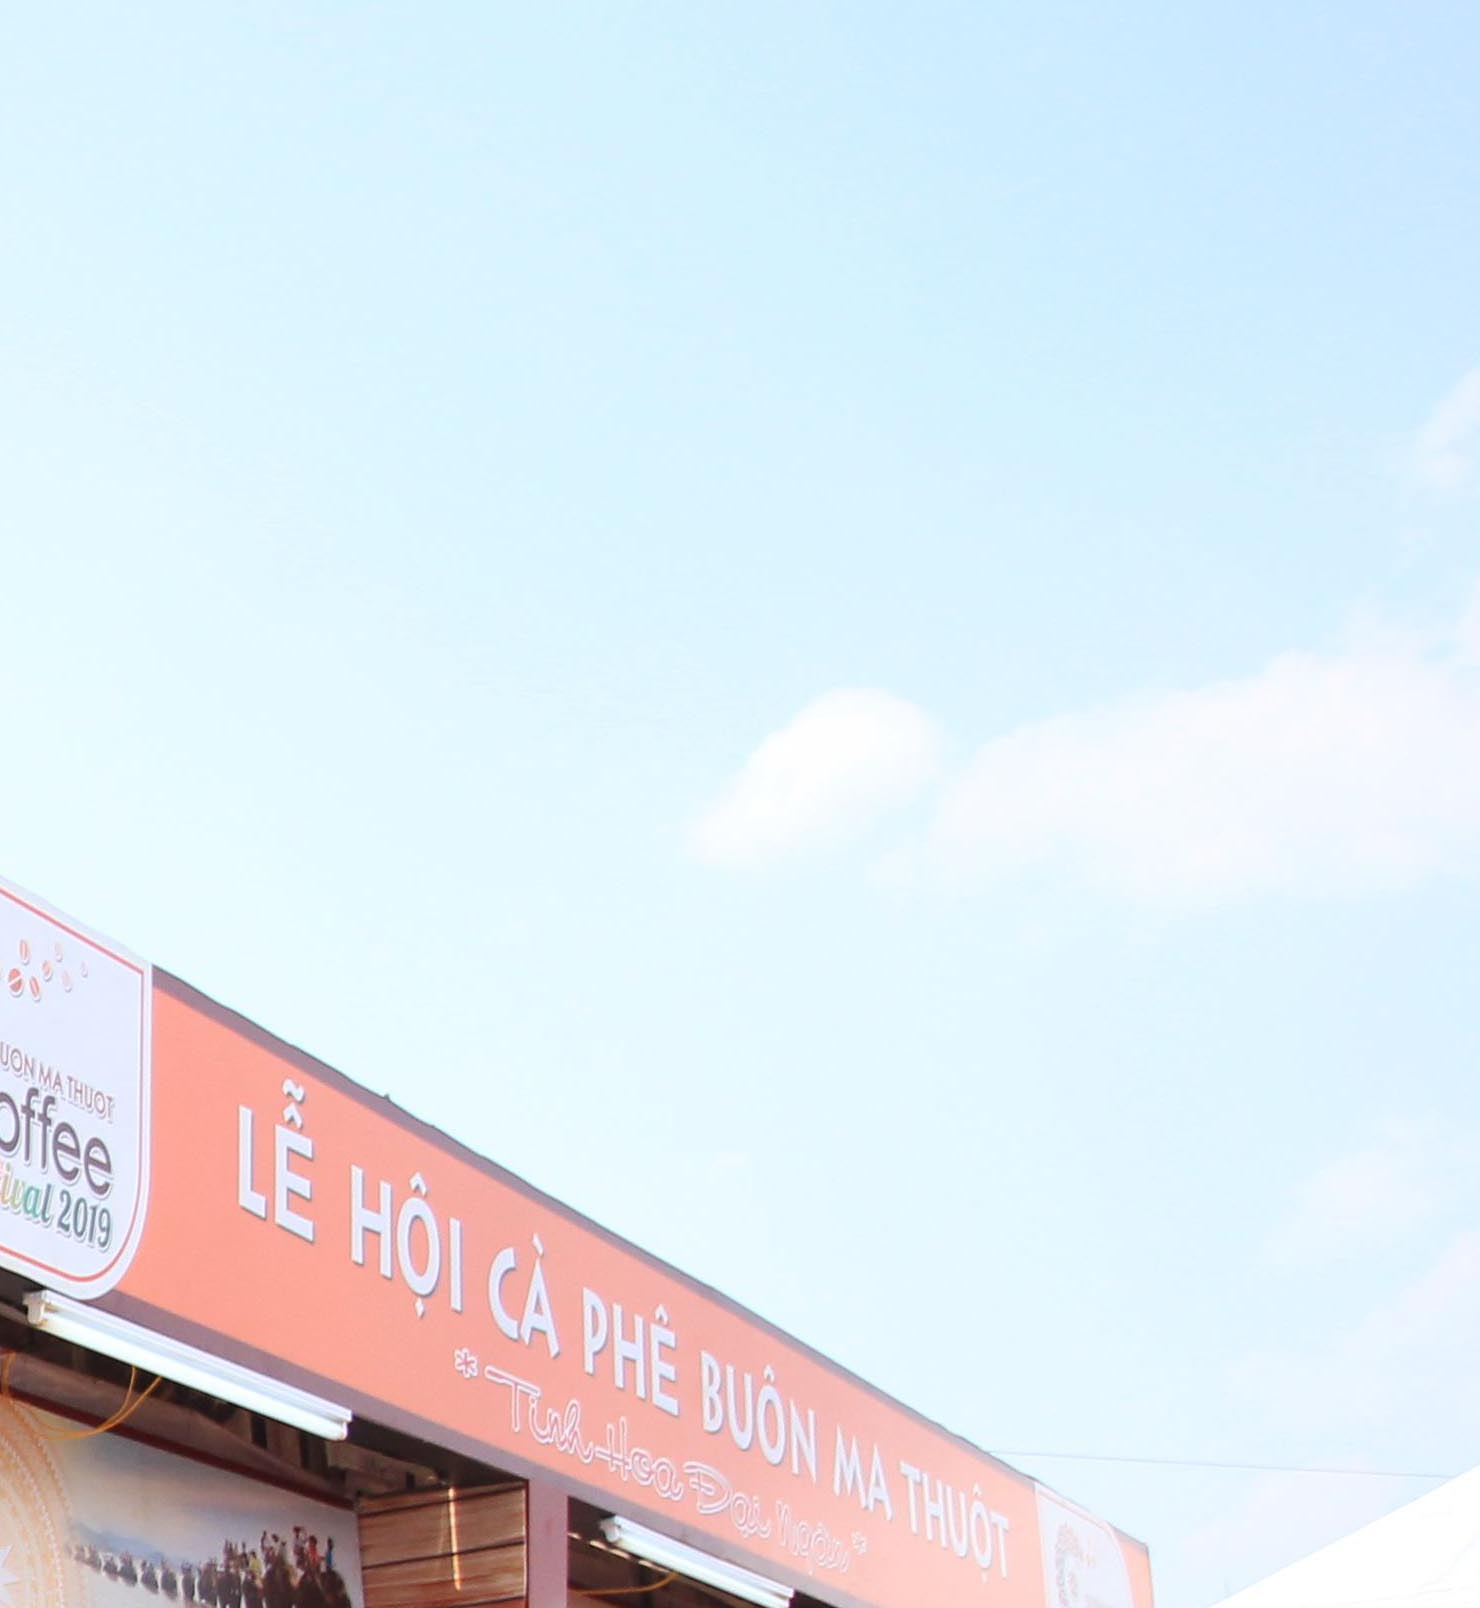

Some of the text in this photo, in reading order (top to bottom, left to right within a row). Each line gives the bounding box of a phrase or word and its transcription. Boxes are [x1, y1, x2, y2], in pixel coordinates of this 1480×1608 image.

[39, 1063, 63, 1090] MA
[66, 1075, 115, 1120] THUOT
[56, 1189, 112, 1249] 2019
[238, 1078, 1009, 1584] LỄ HỘI CÀ PHÊ BUÔN MA THUỘT
